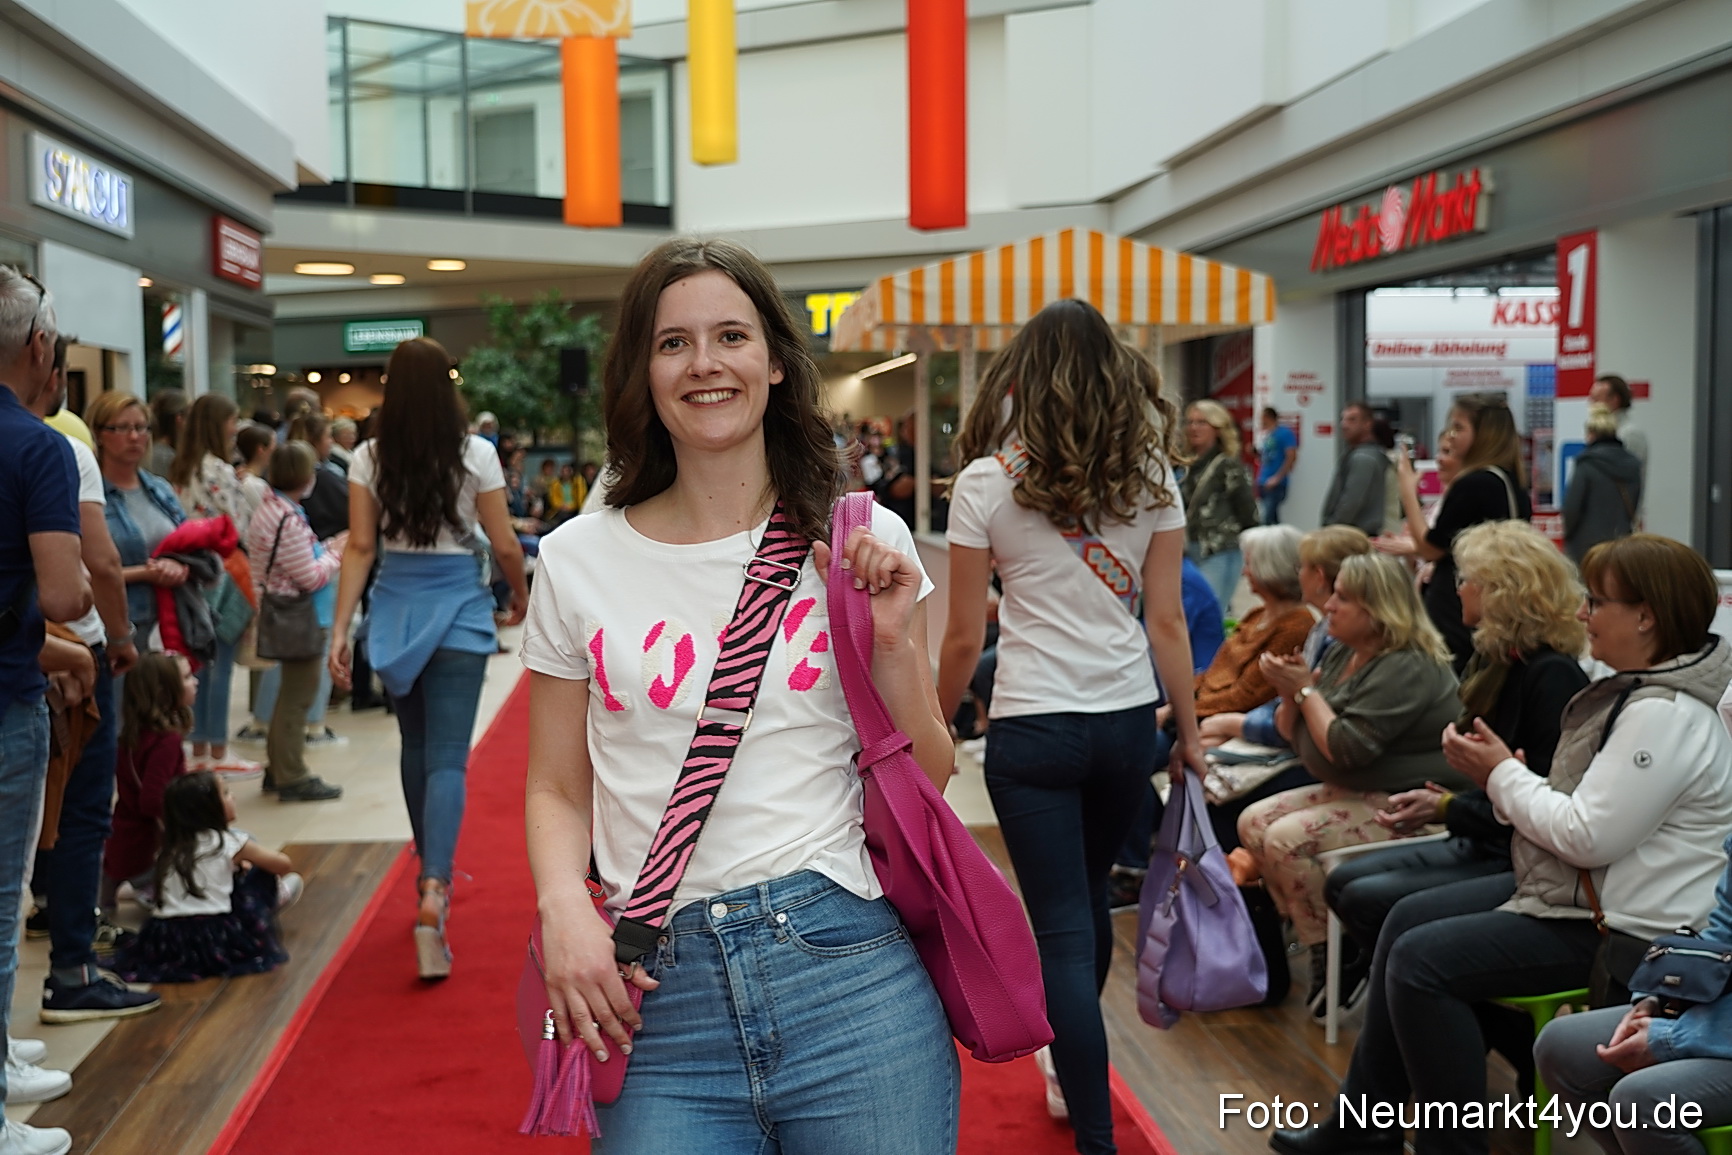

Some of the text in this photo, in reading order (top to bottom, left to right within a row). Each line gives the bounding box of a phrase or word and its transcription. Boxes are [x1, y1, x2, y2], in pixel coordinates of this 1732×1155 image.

[1310, 167, 1482, 273] Media Markt
[586, 597, 831, 713] LOE
